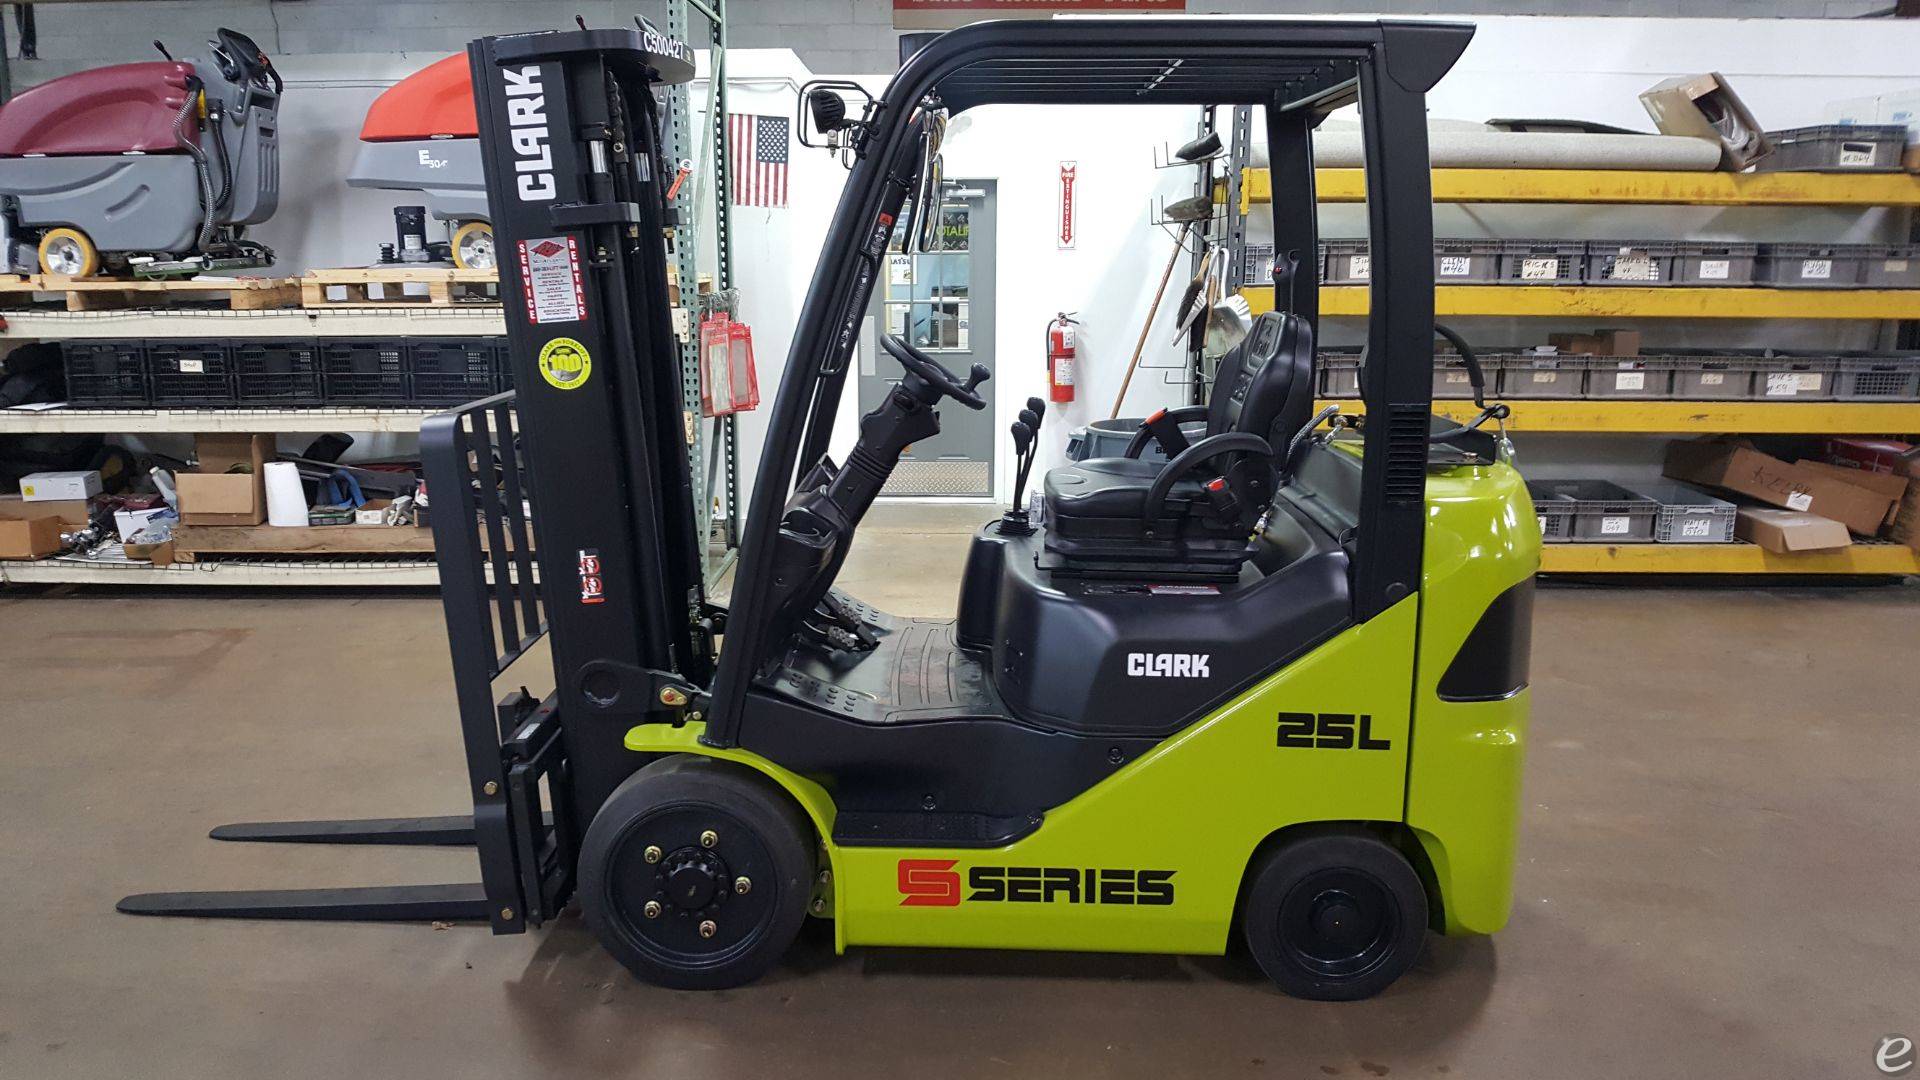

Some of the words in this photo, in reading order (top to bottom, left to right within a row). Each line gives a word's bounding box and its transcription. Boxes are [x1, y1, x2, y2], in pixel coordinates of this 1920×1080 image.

[643, 31, 684, 60] C500427
[502, 65, 557, 202] CLARK
[518, 243, 536, 320] SERVICE
[568, 239, 586, 316] RENTALS
[548, 353, 582, 372] 100
[1127, 653, 1210, 678] CLARK
[1277, 712, 1391, 750] 25L
[898, 859, 960, 907] S
[966, 866, 1178, 906] SERIES
